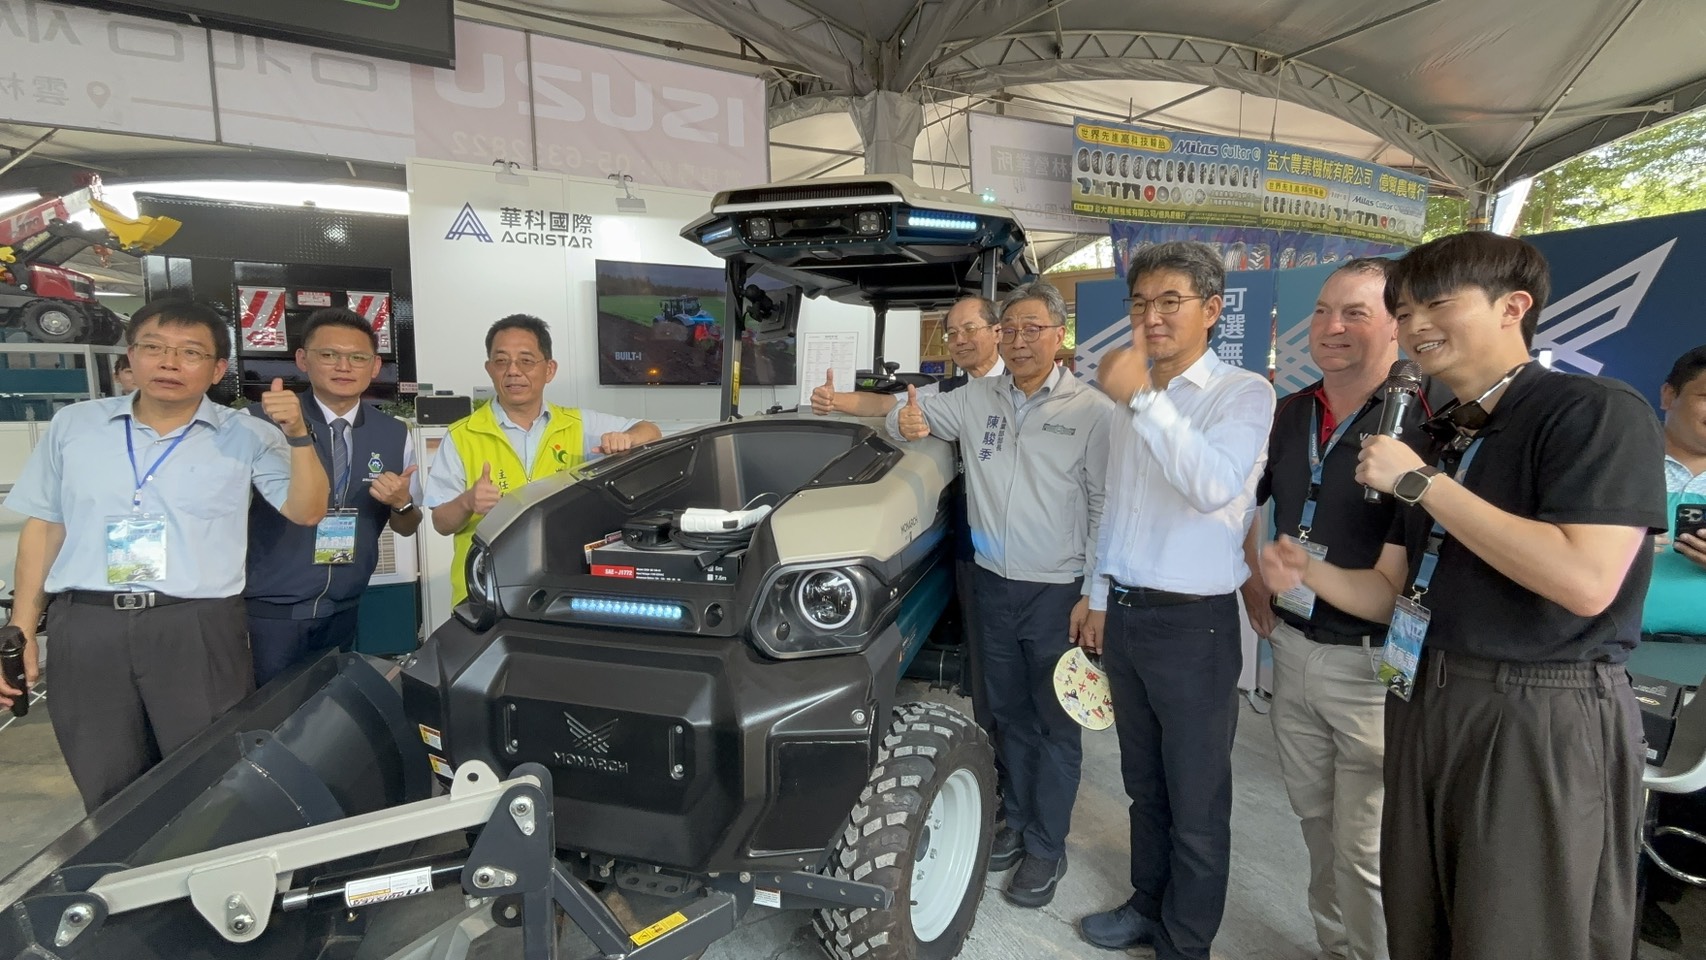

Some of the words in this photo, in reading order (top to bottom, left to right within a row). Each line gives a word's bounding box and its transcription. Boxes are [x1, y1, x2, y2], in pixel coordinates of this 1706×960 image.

[1081, 128, 1167, 150] 世界先進高科技輪胎
[1174, 140, 1219, 156] Mitas
[1220, 144, 1251, 159] Cultor
[1266, 149, 1374, 188] 益大農業機械有限公司
[500, 206, 593, 234] 華科國際
[501, 231, 593, 249] AGRISTAR
[978, 415, 1000, 462] 陳駿季
[554, 752, 628, 773] MONARCH
